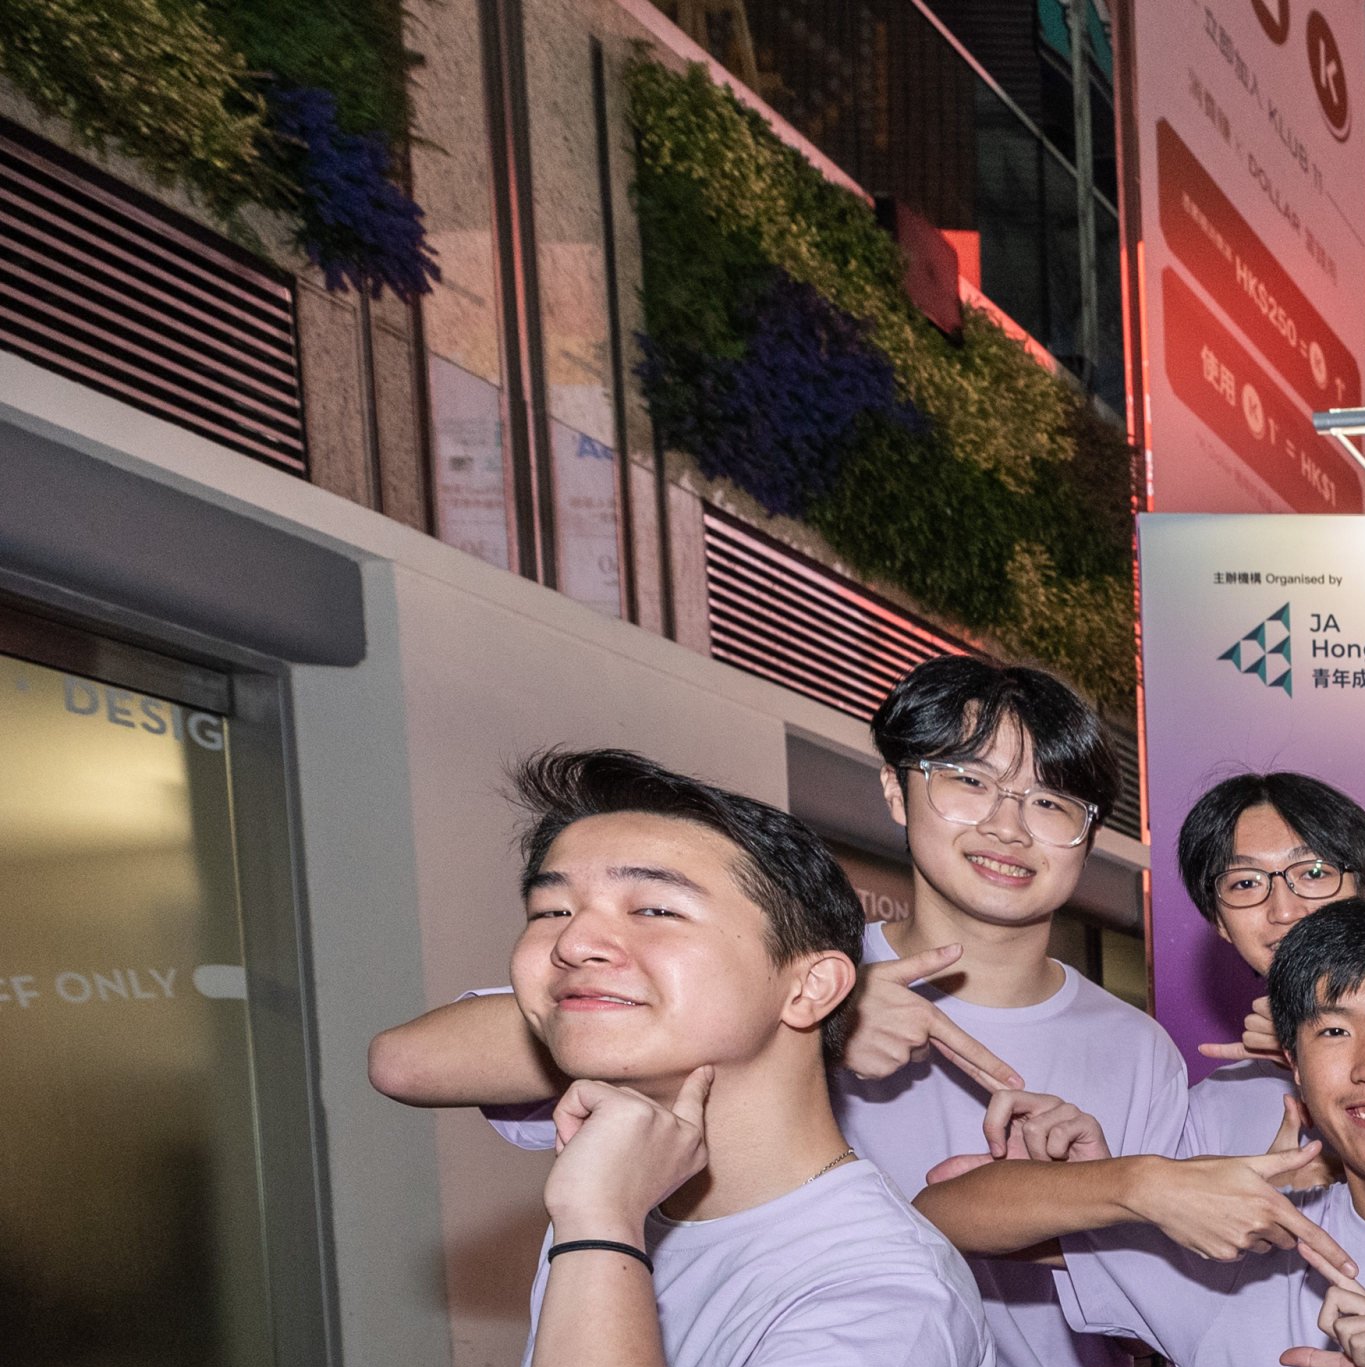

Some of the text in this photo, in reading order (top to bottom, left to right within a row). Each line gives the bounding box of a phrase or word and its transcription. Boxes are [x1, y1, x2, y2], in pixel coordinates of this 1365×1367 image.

[1267, 98, 1309, 175] KLUB
[1236, 256, 1298, 348] HK$250
[1214, 572, 1342, 586] 主辦機構 Organised by
[1310, 614, 1341, 632] JA
[55, 967, 177, 1003] ONLY
